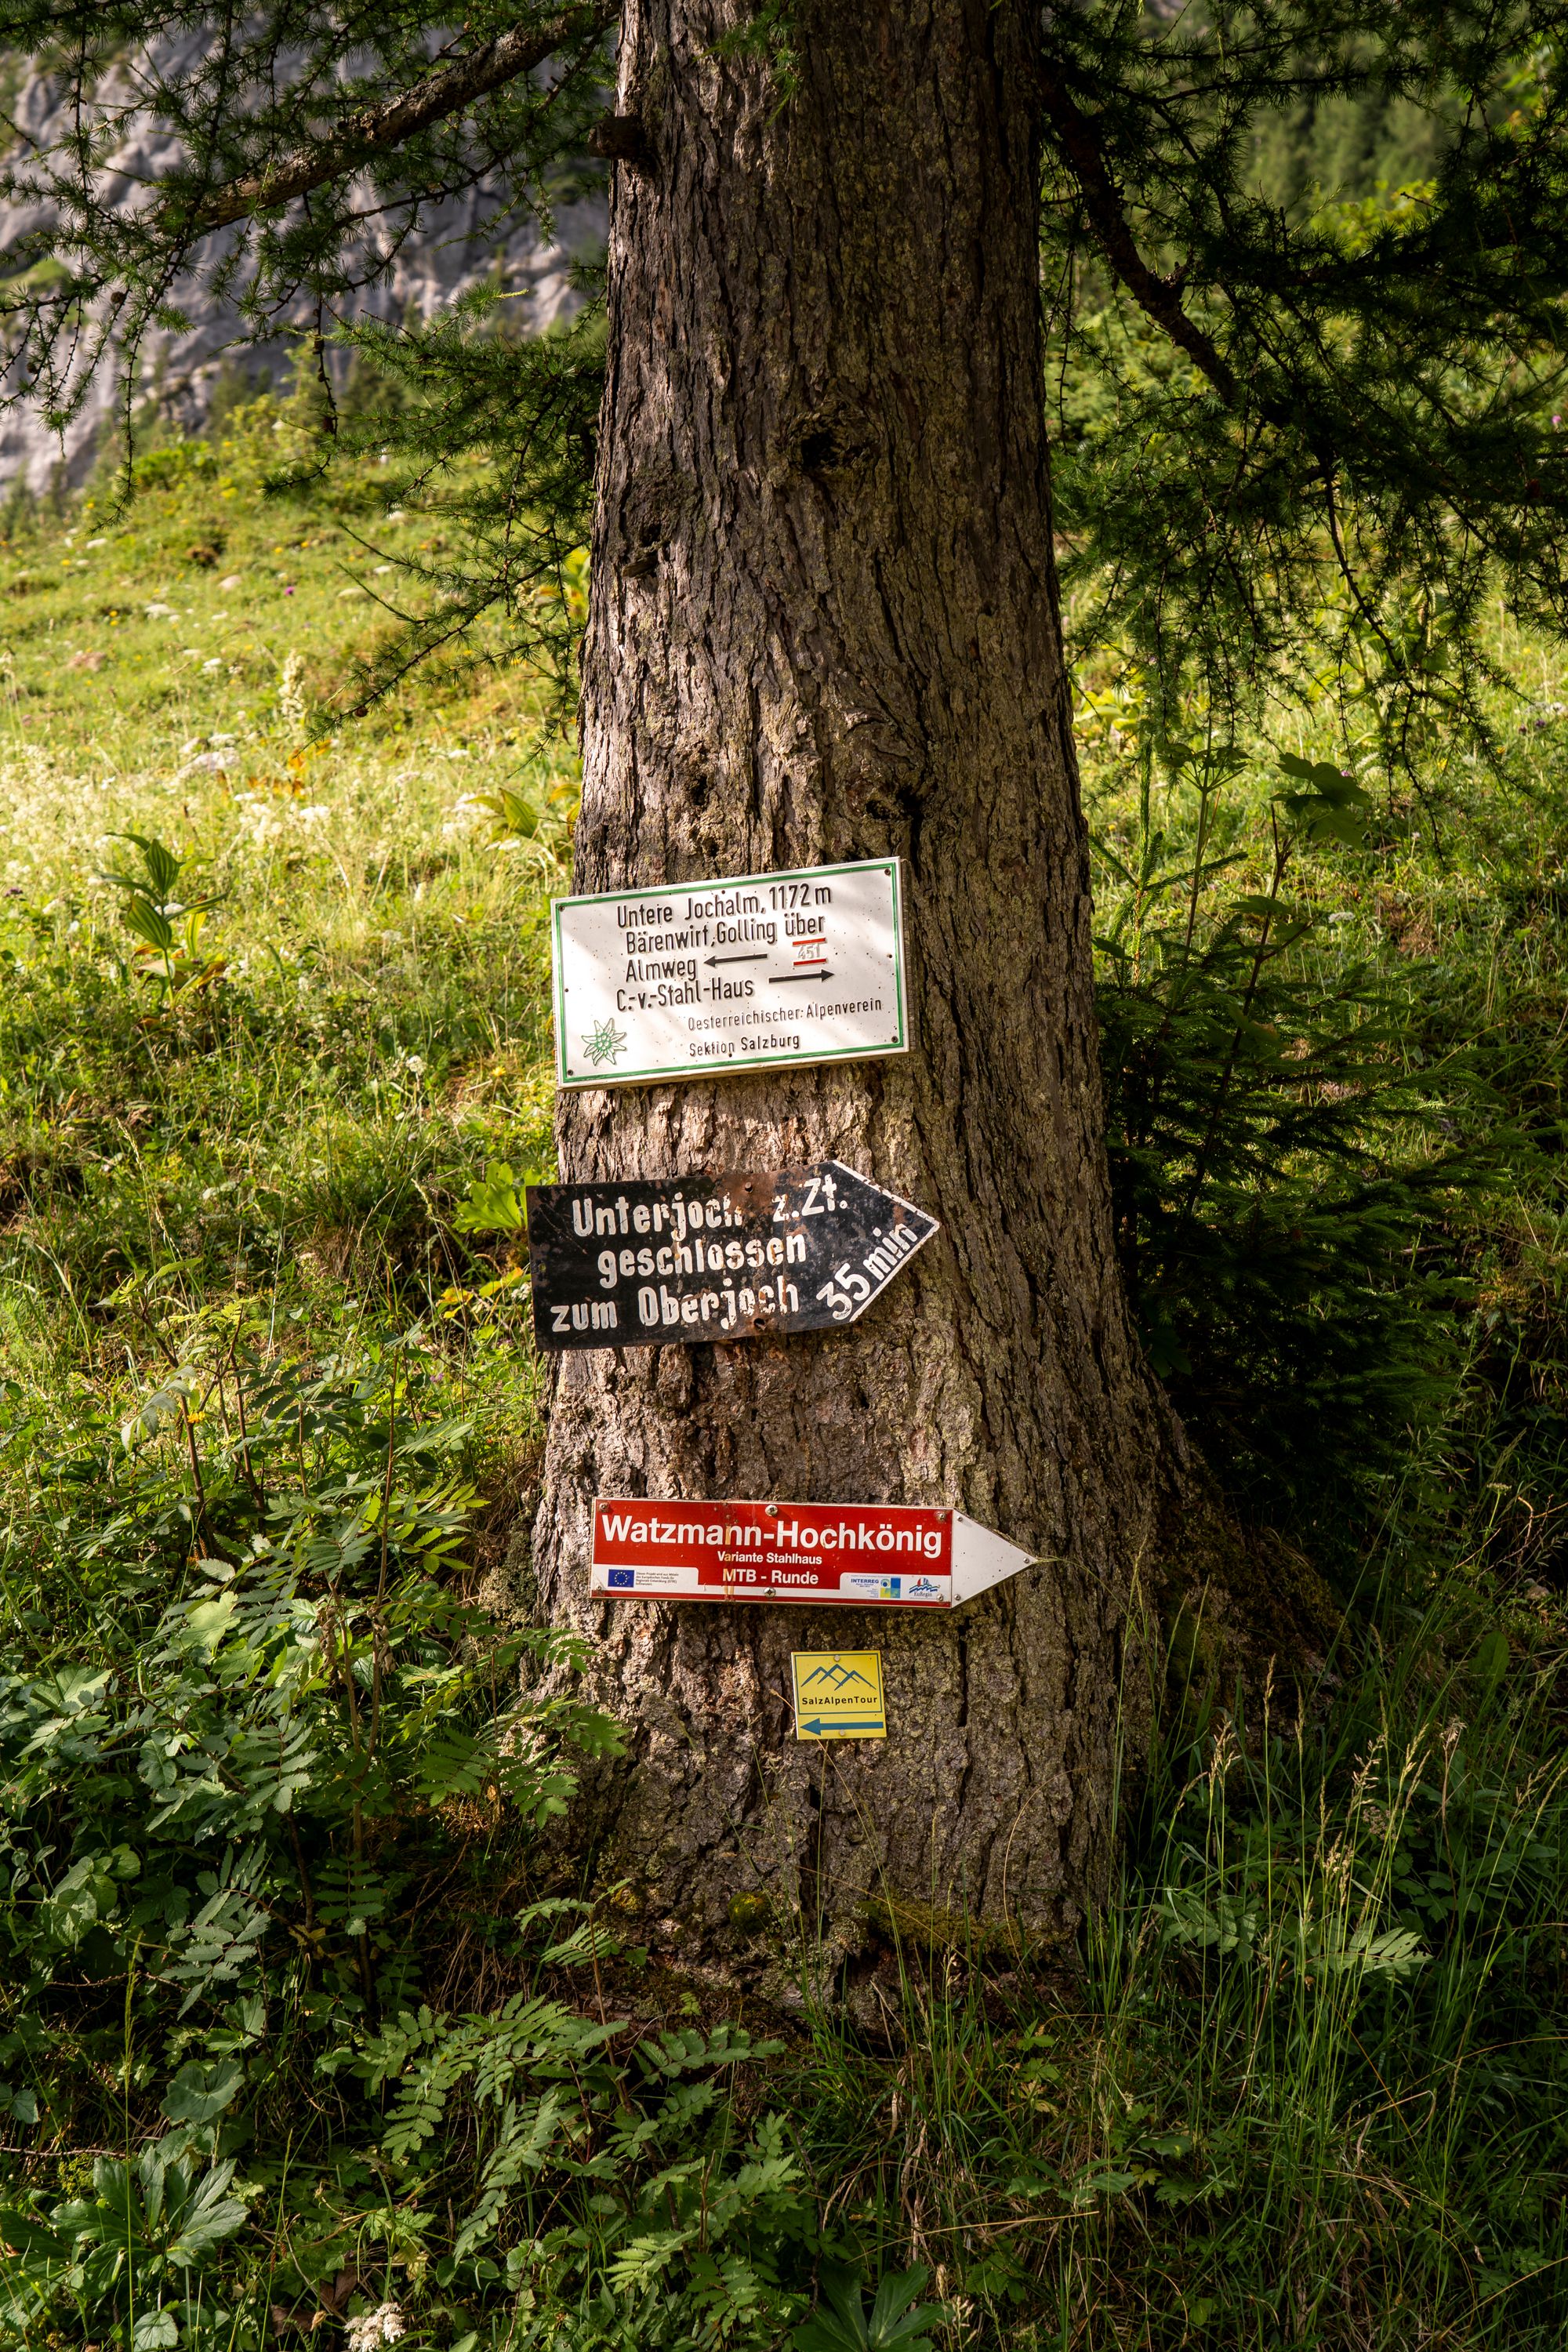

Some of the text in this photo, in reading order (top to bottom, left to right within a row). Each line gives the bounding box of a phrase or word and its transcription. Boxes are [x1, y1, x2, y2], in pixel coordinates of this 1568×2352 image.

[617, 883, 831, 928] Untere Jochalm, 1172 m
[784, 913, 826, 936] über
[797, 943, 820, 960] 451
[626, 959, 697, 983] Almweg
[806, 998, 882, 1020] Alpenverein
[689, 1034, 800, 1057] Sektion Salzburg
[597, 1233, 807, 1289] geschlossen
[815, 1223, 918, 1321] 35 min
[550, 1275, 800, 1333] zum Oberjoch
[601, 1514, 943, 1558] Watzmann-Hochkönig
[717, 1551, 822, 1565] Variante Stahlhaus
[723, 1568, 757, 1582] MTB
[771, 1570, 818, 1584] Runde
[801, 1696, 877, 1705] SalzAlpenTour
